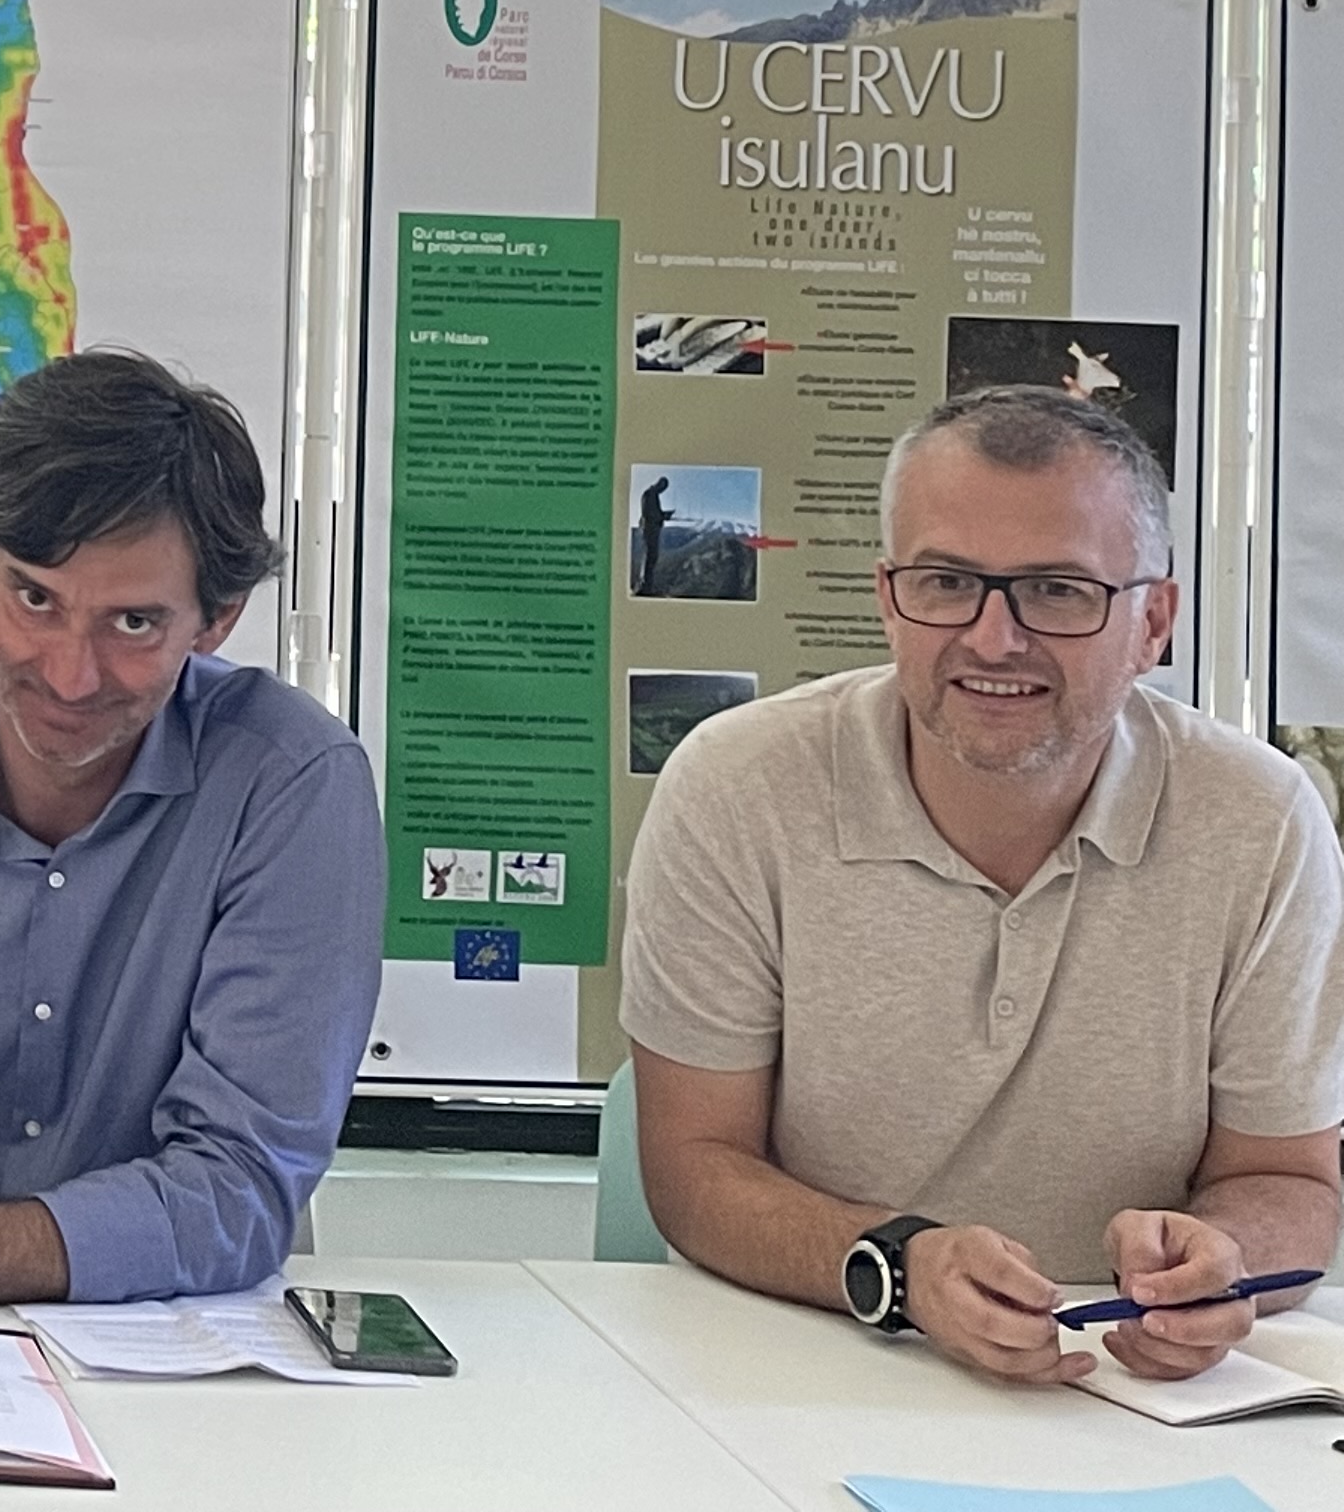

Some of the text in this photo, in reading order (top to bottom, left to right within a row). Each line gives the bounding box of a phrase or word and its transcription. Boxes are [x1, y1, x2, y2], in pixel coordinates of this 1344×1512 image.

[500, 7, 529, 23] Parc
[674, 38, 1005, 120] U CERVU
[719, 114, 956, 195] isulanu
[750, 196, 797, 215] Life
[967, 207, 1033, 223] U cervu
[769, 218, 808, 231] one
[480, 232, 506, 243] que
[753, 230, 896, 251] two islands
[412, 240, 548, 257] le programme LIFE ?
[634, 251, 658, 265] Les
[660, 254, 715, 268] grandes
[718, 256, 768, 268] actions
[770, 257, 789, 270] du
[790, 259, 865, 273] programme
[867, 260, 897, 273] LIFE
[983, 269, 1032, 284] tocca
